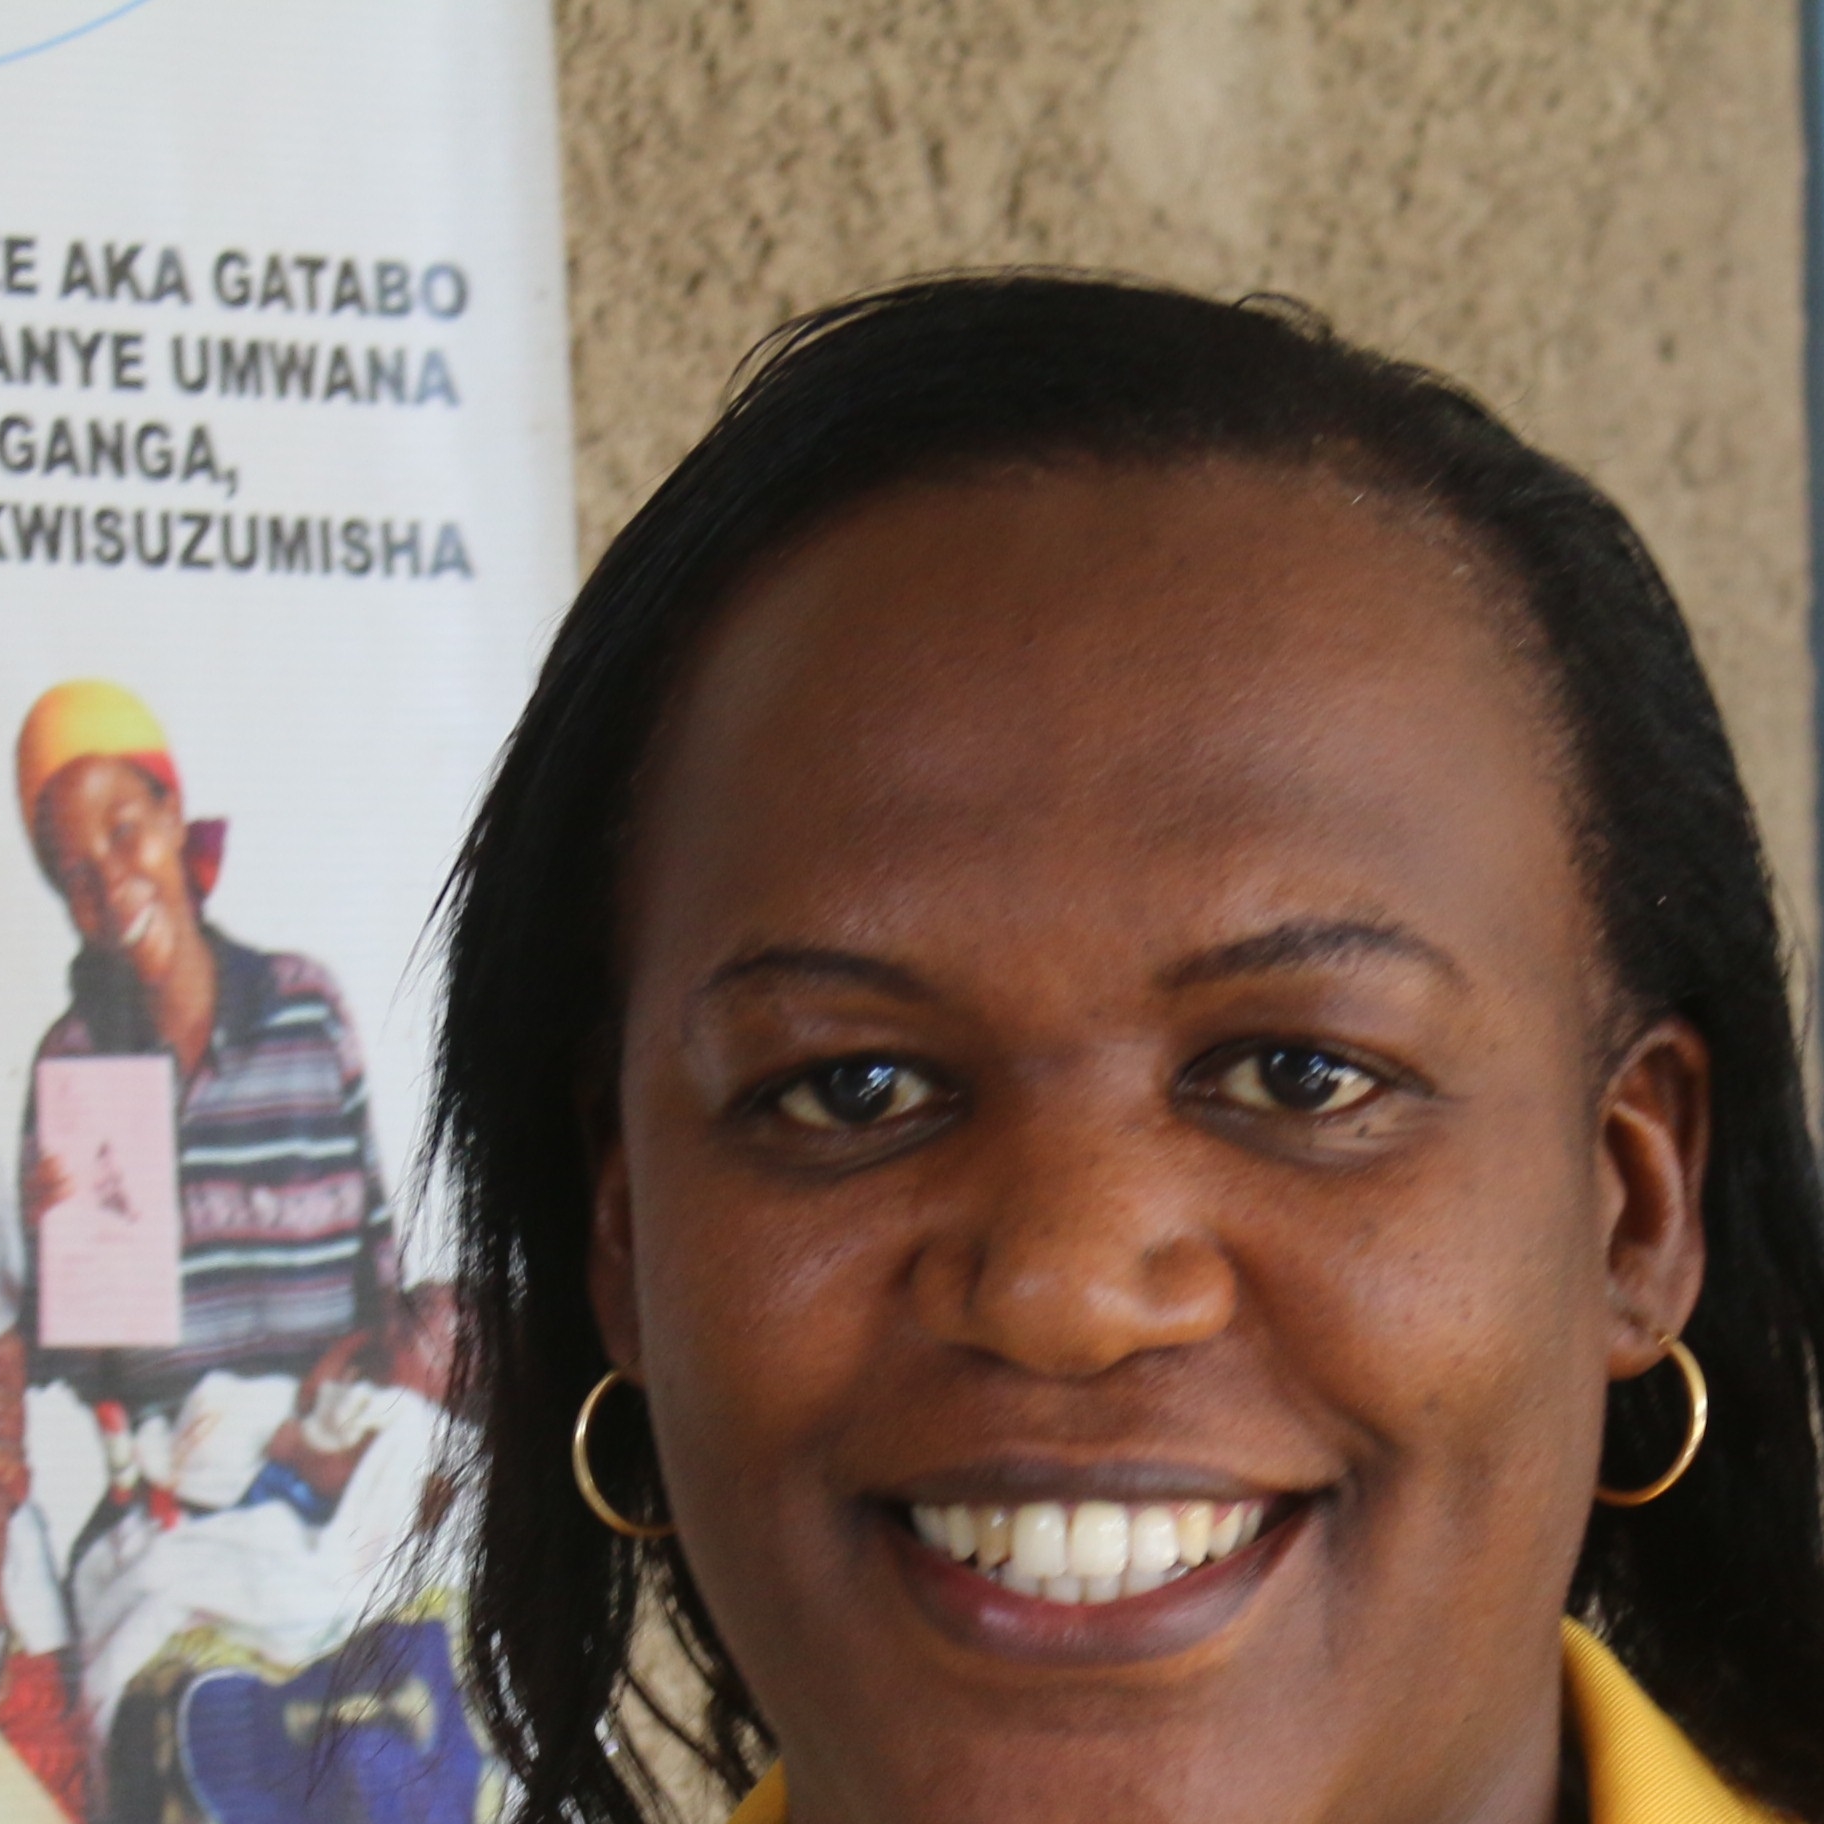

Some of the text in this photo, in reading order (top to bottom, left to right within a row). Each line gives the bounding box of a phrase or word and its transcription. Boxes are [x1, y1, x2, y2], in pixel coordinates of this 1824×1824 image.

[57, 239, 194, 307] AKA
[210, 247, 471, 321] GATABO
[169, 334, 459, 406] UMWANA
